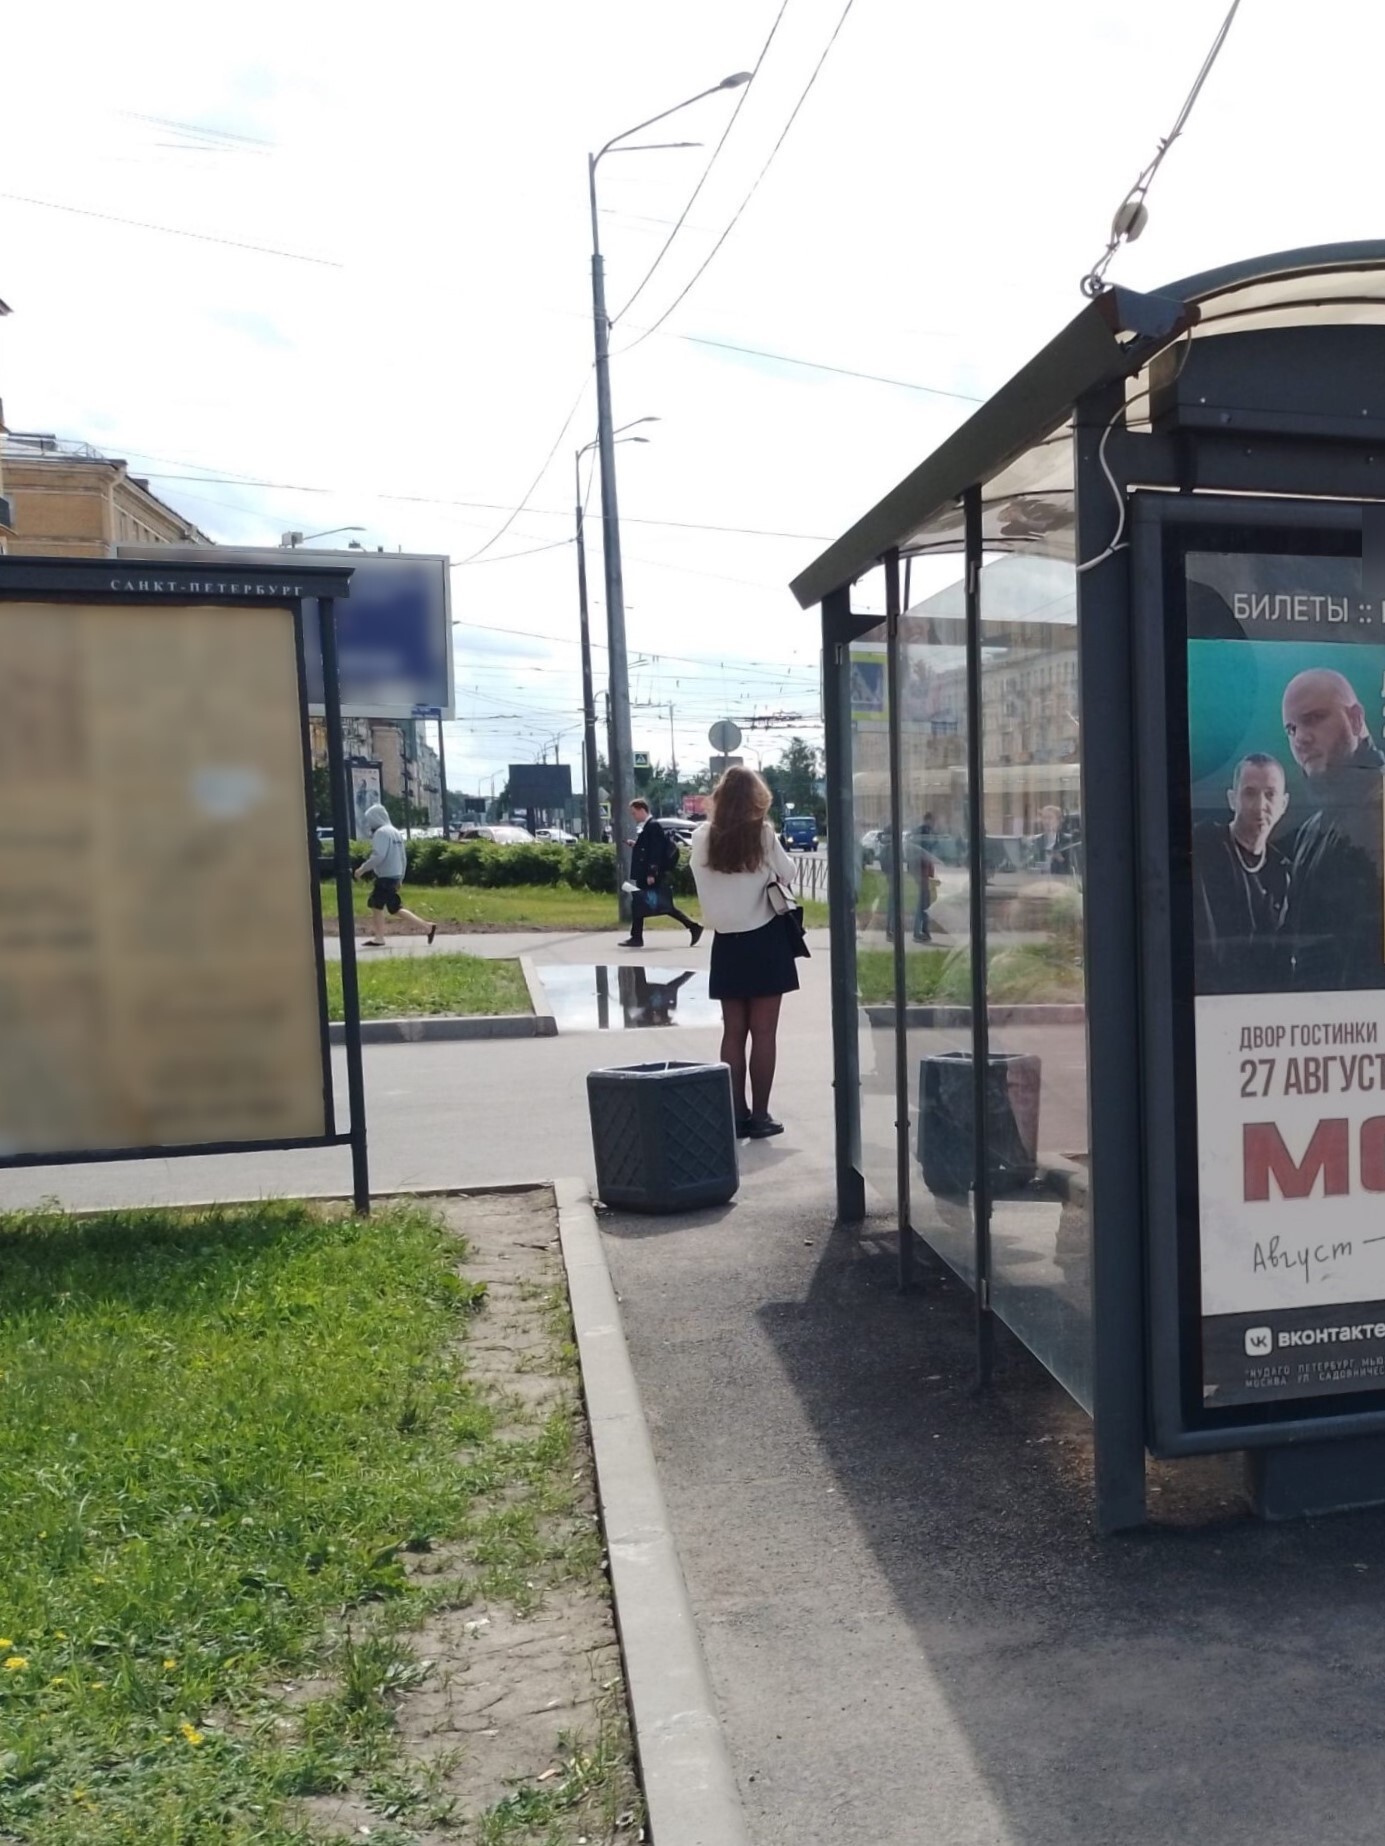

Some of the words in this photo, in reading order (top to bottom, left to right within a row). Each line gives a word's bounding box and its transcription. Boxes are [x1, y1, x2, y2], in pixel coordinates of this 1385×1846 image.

[110, 579, 304, 597] САНКТ-ПЕТЕРБУРГ
[1233, 593, 1348, 623] БИЛЕТЫ
[1240, 1024, 1286, 1052] ДВОР
[1290, 1021, 1378, 1047] ГОСТИНКИ
[1240, 1058, 1277, 1098] 27
[1252, 1235, 1353, 1284] Август
